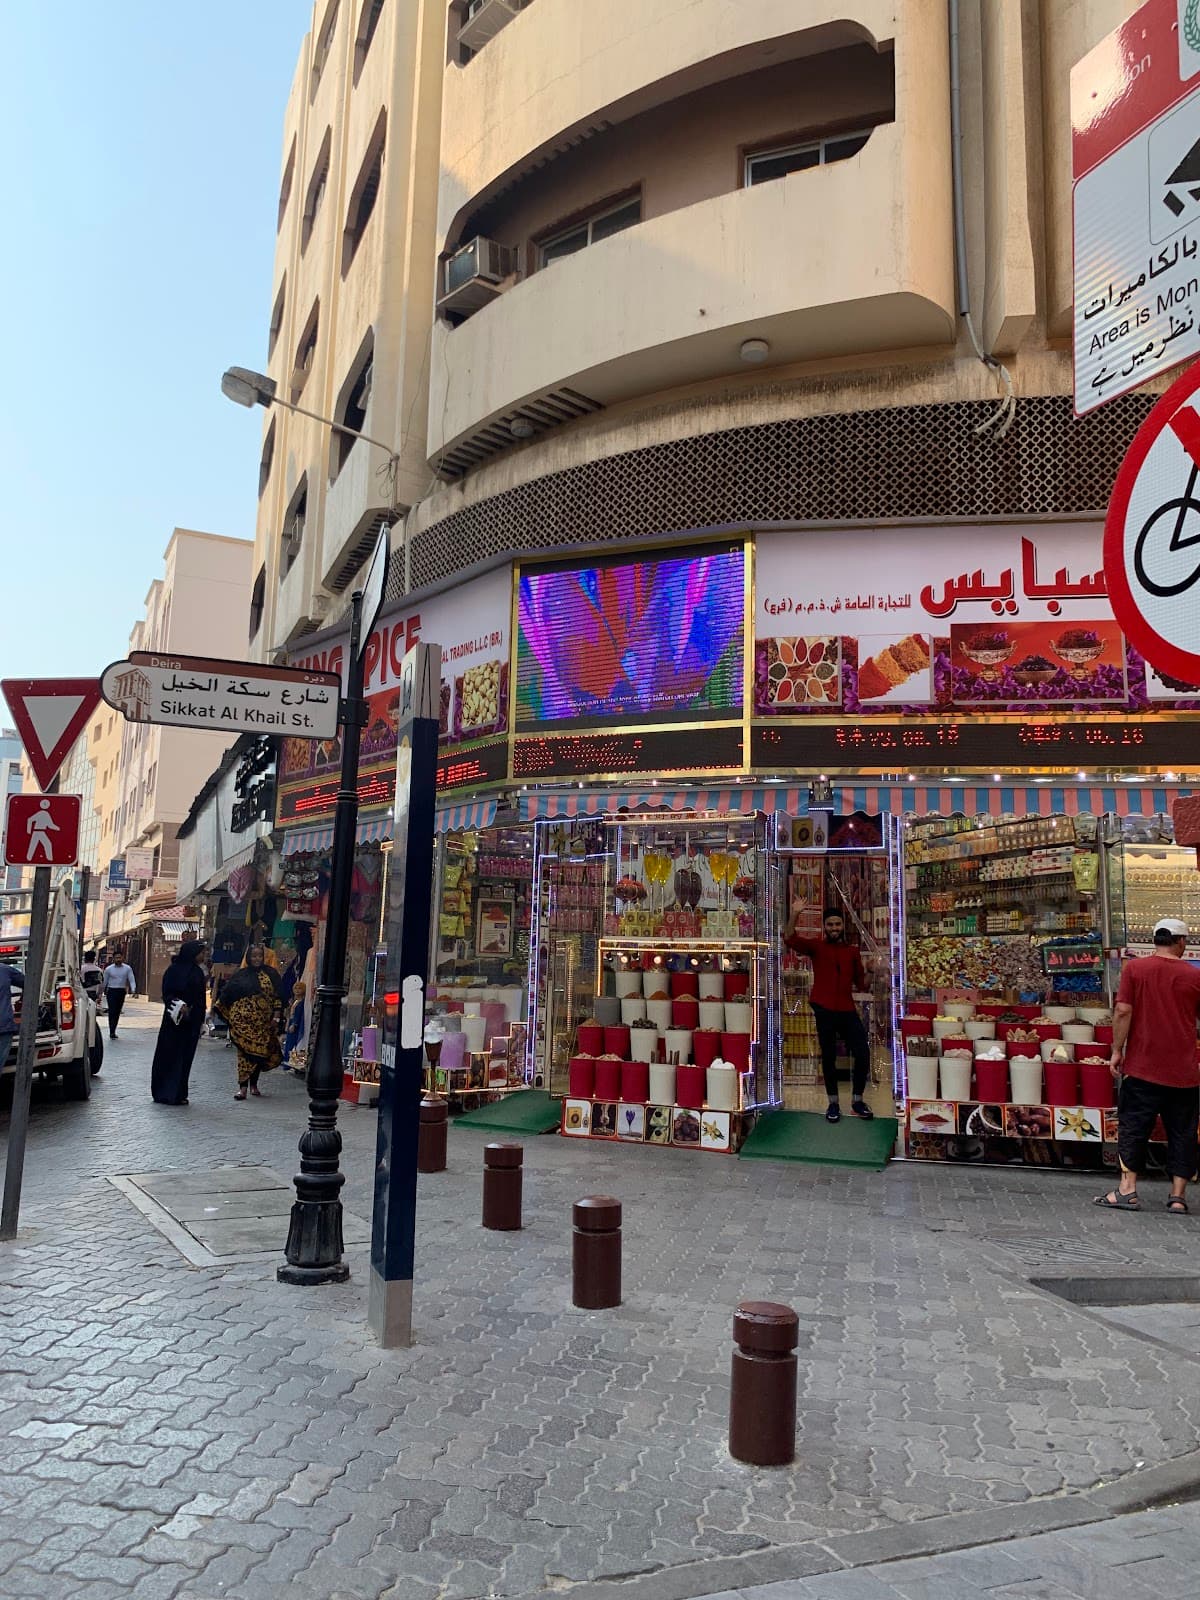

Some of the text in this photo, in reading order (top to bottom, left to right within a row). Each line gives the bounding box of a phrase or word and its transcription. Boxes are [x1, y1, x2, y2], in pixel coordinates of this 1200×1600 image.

[1084, 235, 1198, 321] بالكاميرات
[1089, 278, 1199, 356] Area is Mon
[845, 595, 875, 609] العامة
[878, 593, 912, 612] للتجارة
[450, 640, 474, 661] TRADING
[151, 657, 182, 670] Deira
[162, 674, 329, 706] شارع سكة الخيل
[160, 700, 314, 728] Sikkat Al Khail St.
